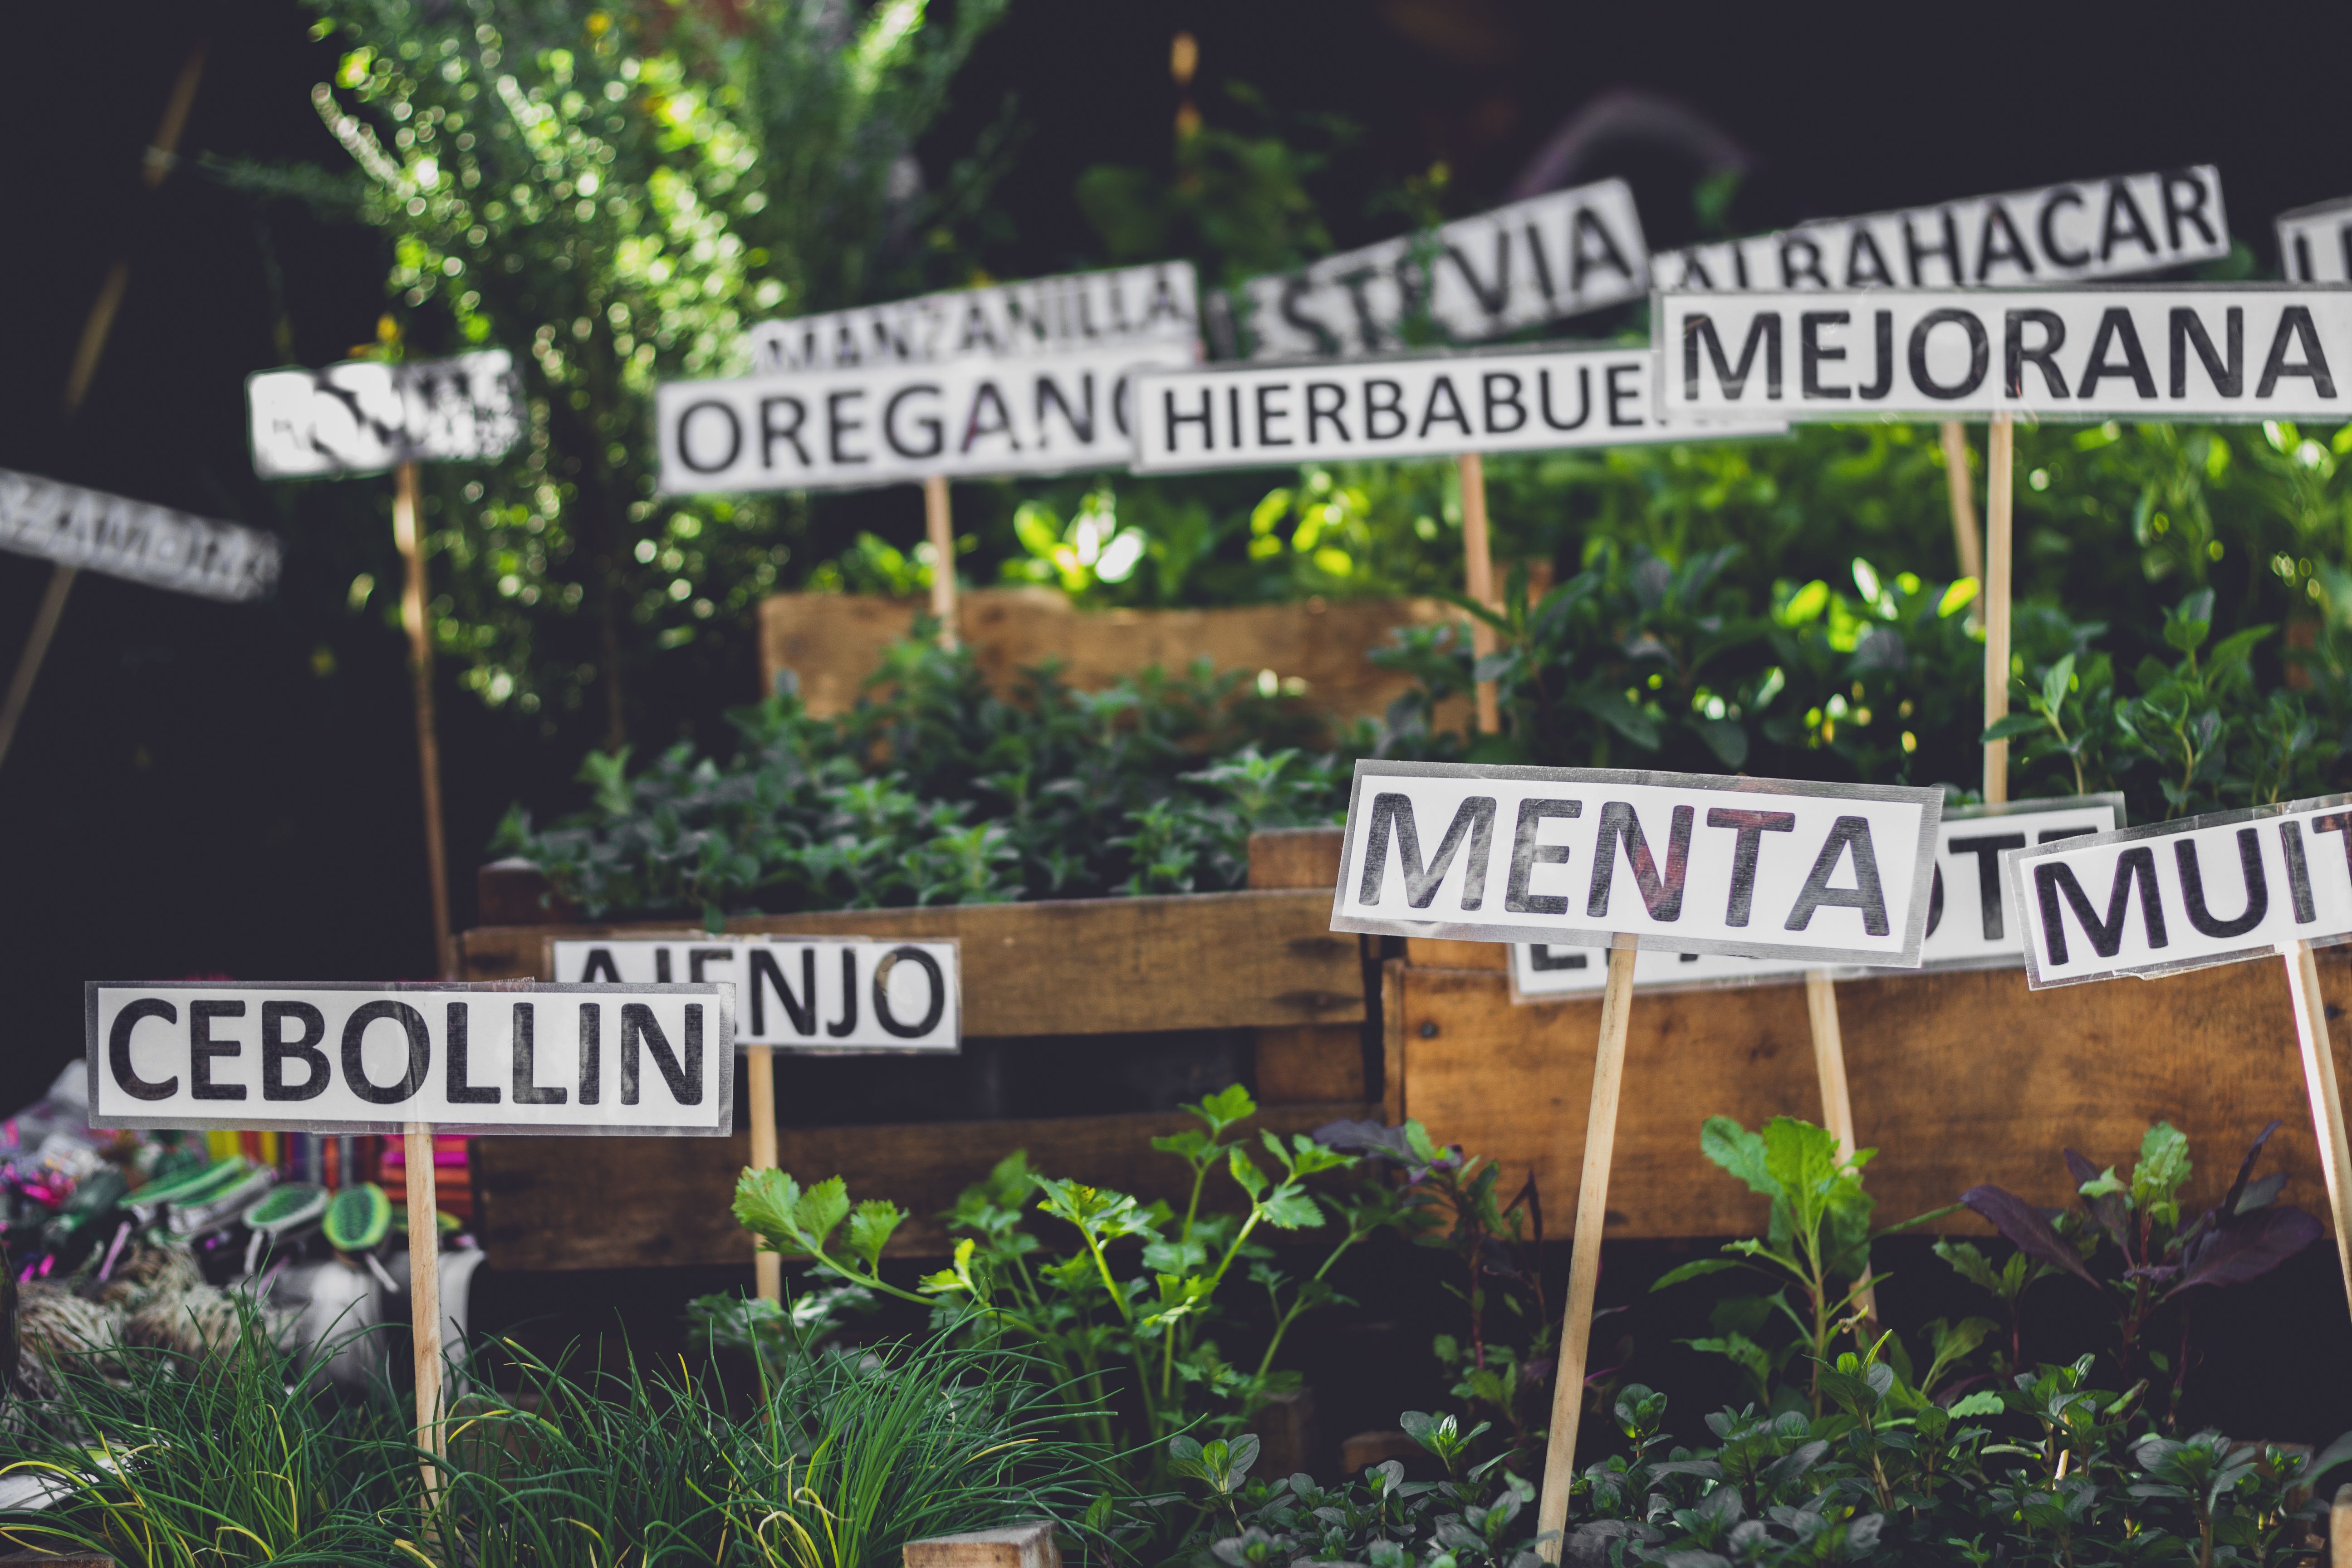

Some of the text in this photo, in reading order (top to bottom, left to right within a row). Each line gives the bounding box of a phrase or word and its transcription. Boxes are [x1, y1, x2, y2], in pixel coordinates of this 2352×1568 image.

[1683, 305, 2337, 399] MEJORANA
[676, 370, 1135, 474] OREGAN
[1164, 362, 1730, 452] HIERBABUE
[1358, 792, 1891, 937] MENTA
[108, 997, 704, 1106] CEBOLLIN
